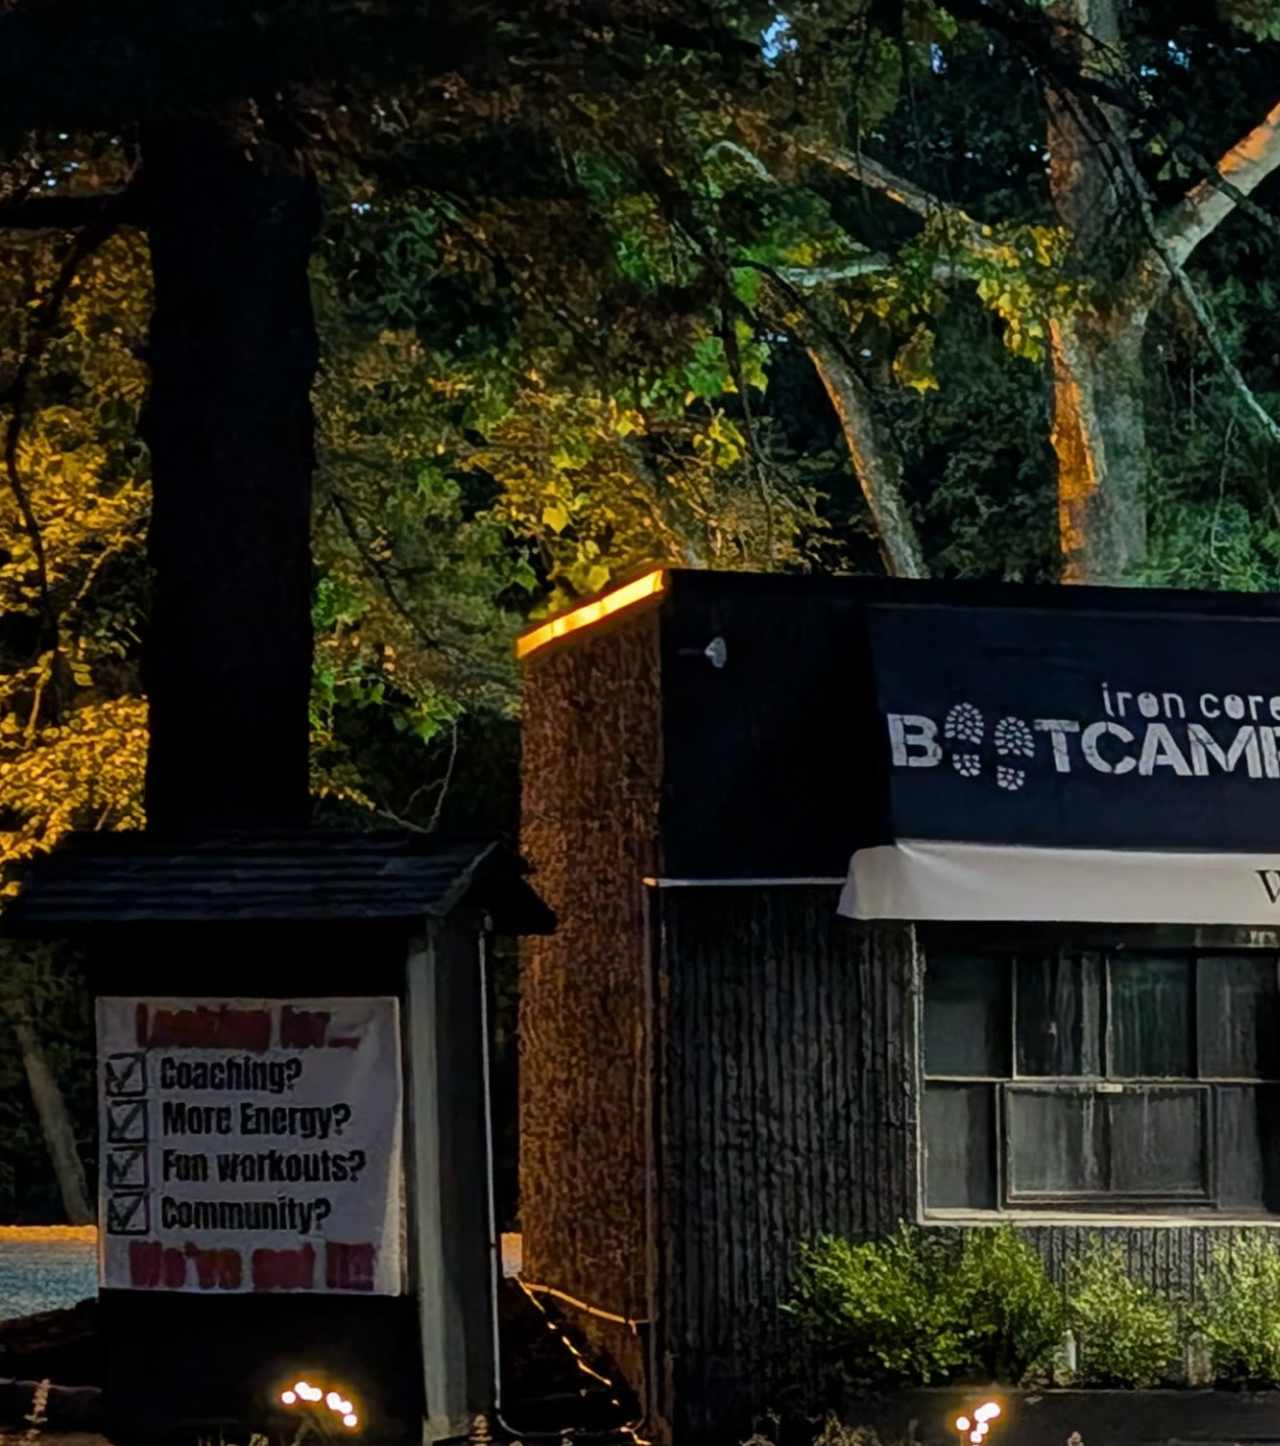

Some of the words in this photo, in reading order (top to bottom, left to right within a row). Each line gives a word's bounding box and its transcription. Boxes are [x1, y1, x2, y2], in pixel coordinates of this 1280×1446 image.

[1101, 682, 1186, 719] iron
[160, 1056, 304, 1094] Coaching?
[162, 1101, 233, 1136] More
[239, 1102, 352, 1140] Energy?
[162, 1149, 209, 1183] Fun
[216, 1149, 367, 1184] workouts?
[160, 1195, 332, 1234] Community?
